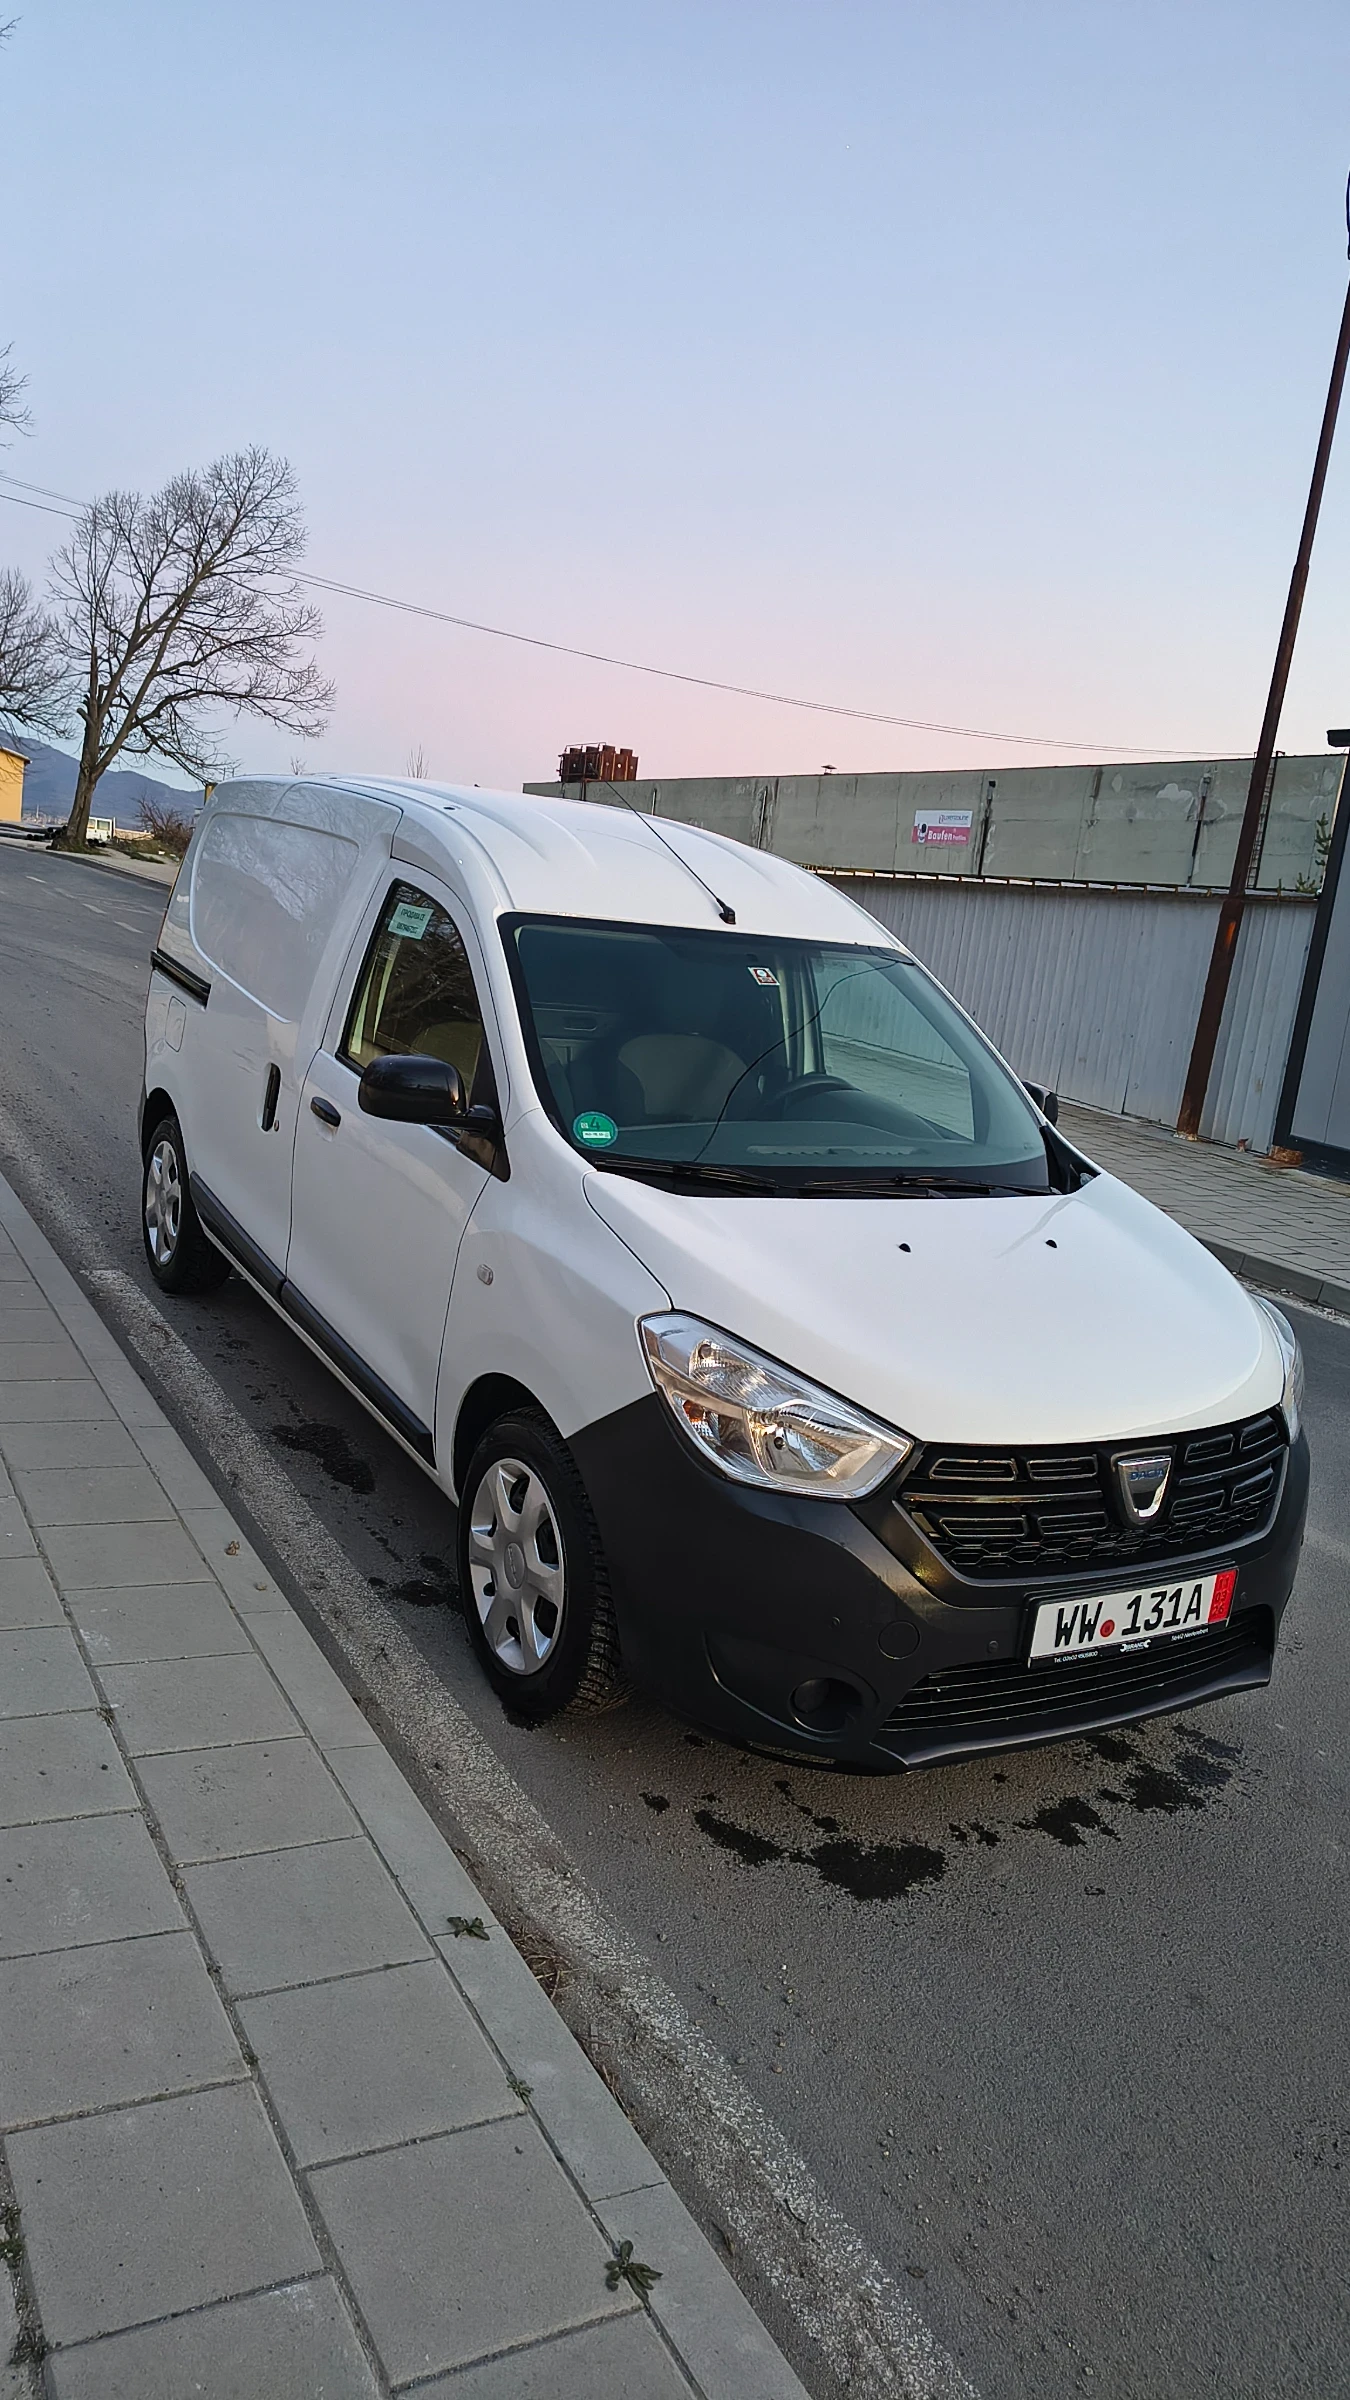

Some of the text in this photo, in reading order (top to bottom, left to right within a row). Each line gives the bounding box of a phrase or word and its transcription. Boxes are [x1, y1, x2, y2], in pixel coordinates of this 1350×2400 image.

[590, 1116, 600, 1130] 4
[1054, 1583, 1203, 1648] WW 131A
